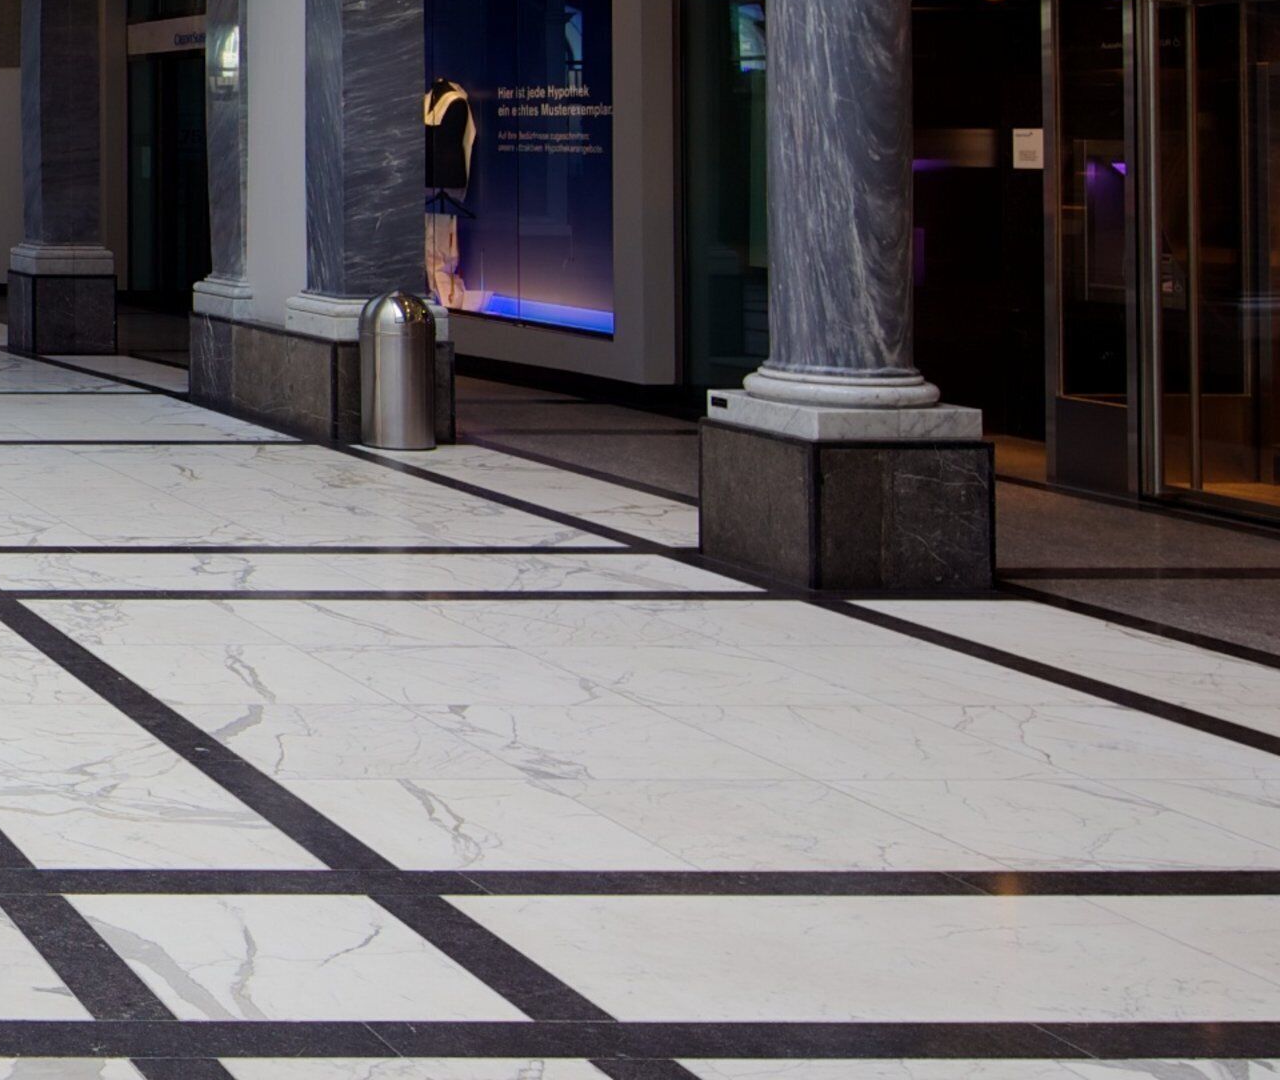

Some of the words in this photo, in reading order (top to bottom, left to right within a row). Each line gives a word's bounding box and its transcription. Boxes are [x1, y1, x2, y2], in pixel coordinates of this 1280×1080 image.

[498, 87, 513, 99] Hier
[515, 87, 525, 98] ist
[526, 86, 545, 100] jede
[547, 84, 590, 100] Hypothek
[497, 105, 510, 116] ein
